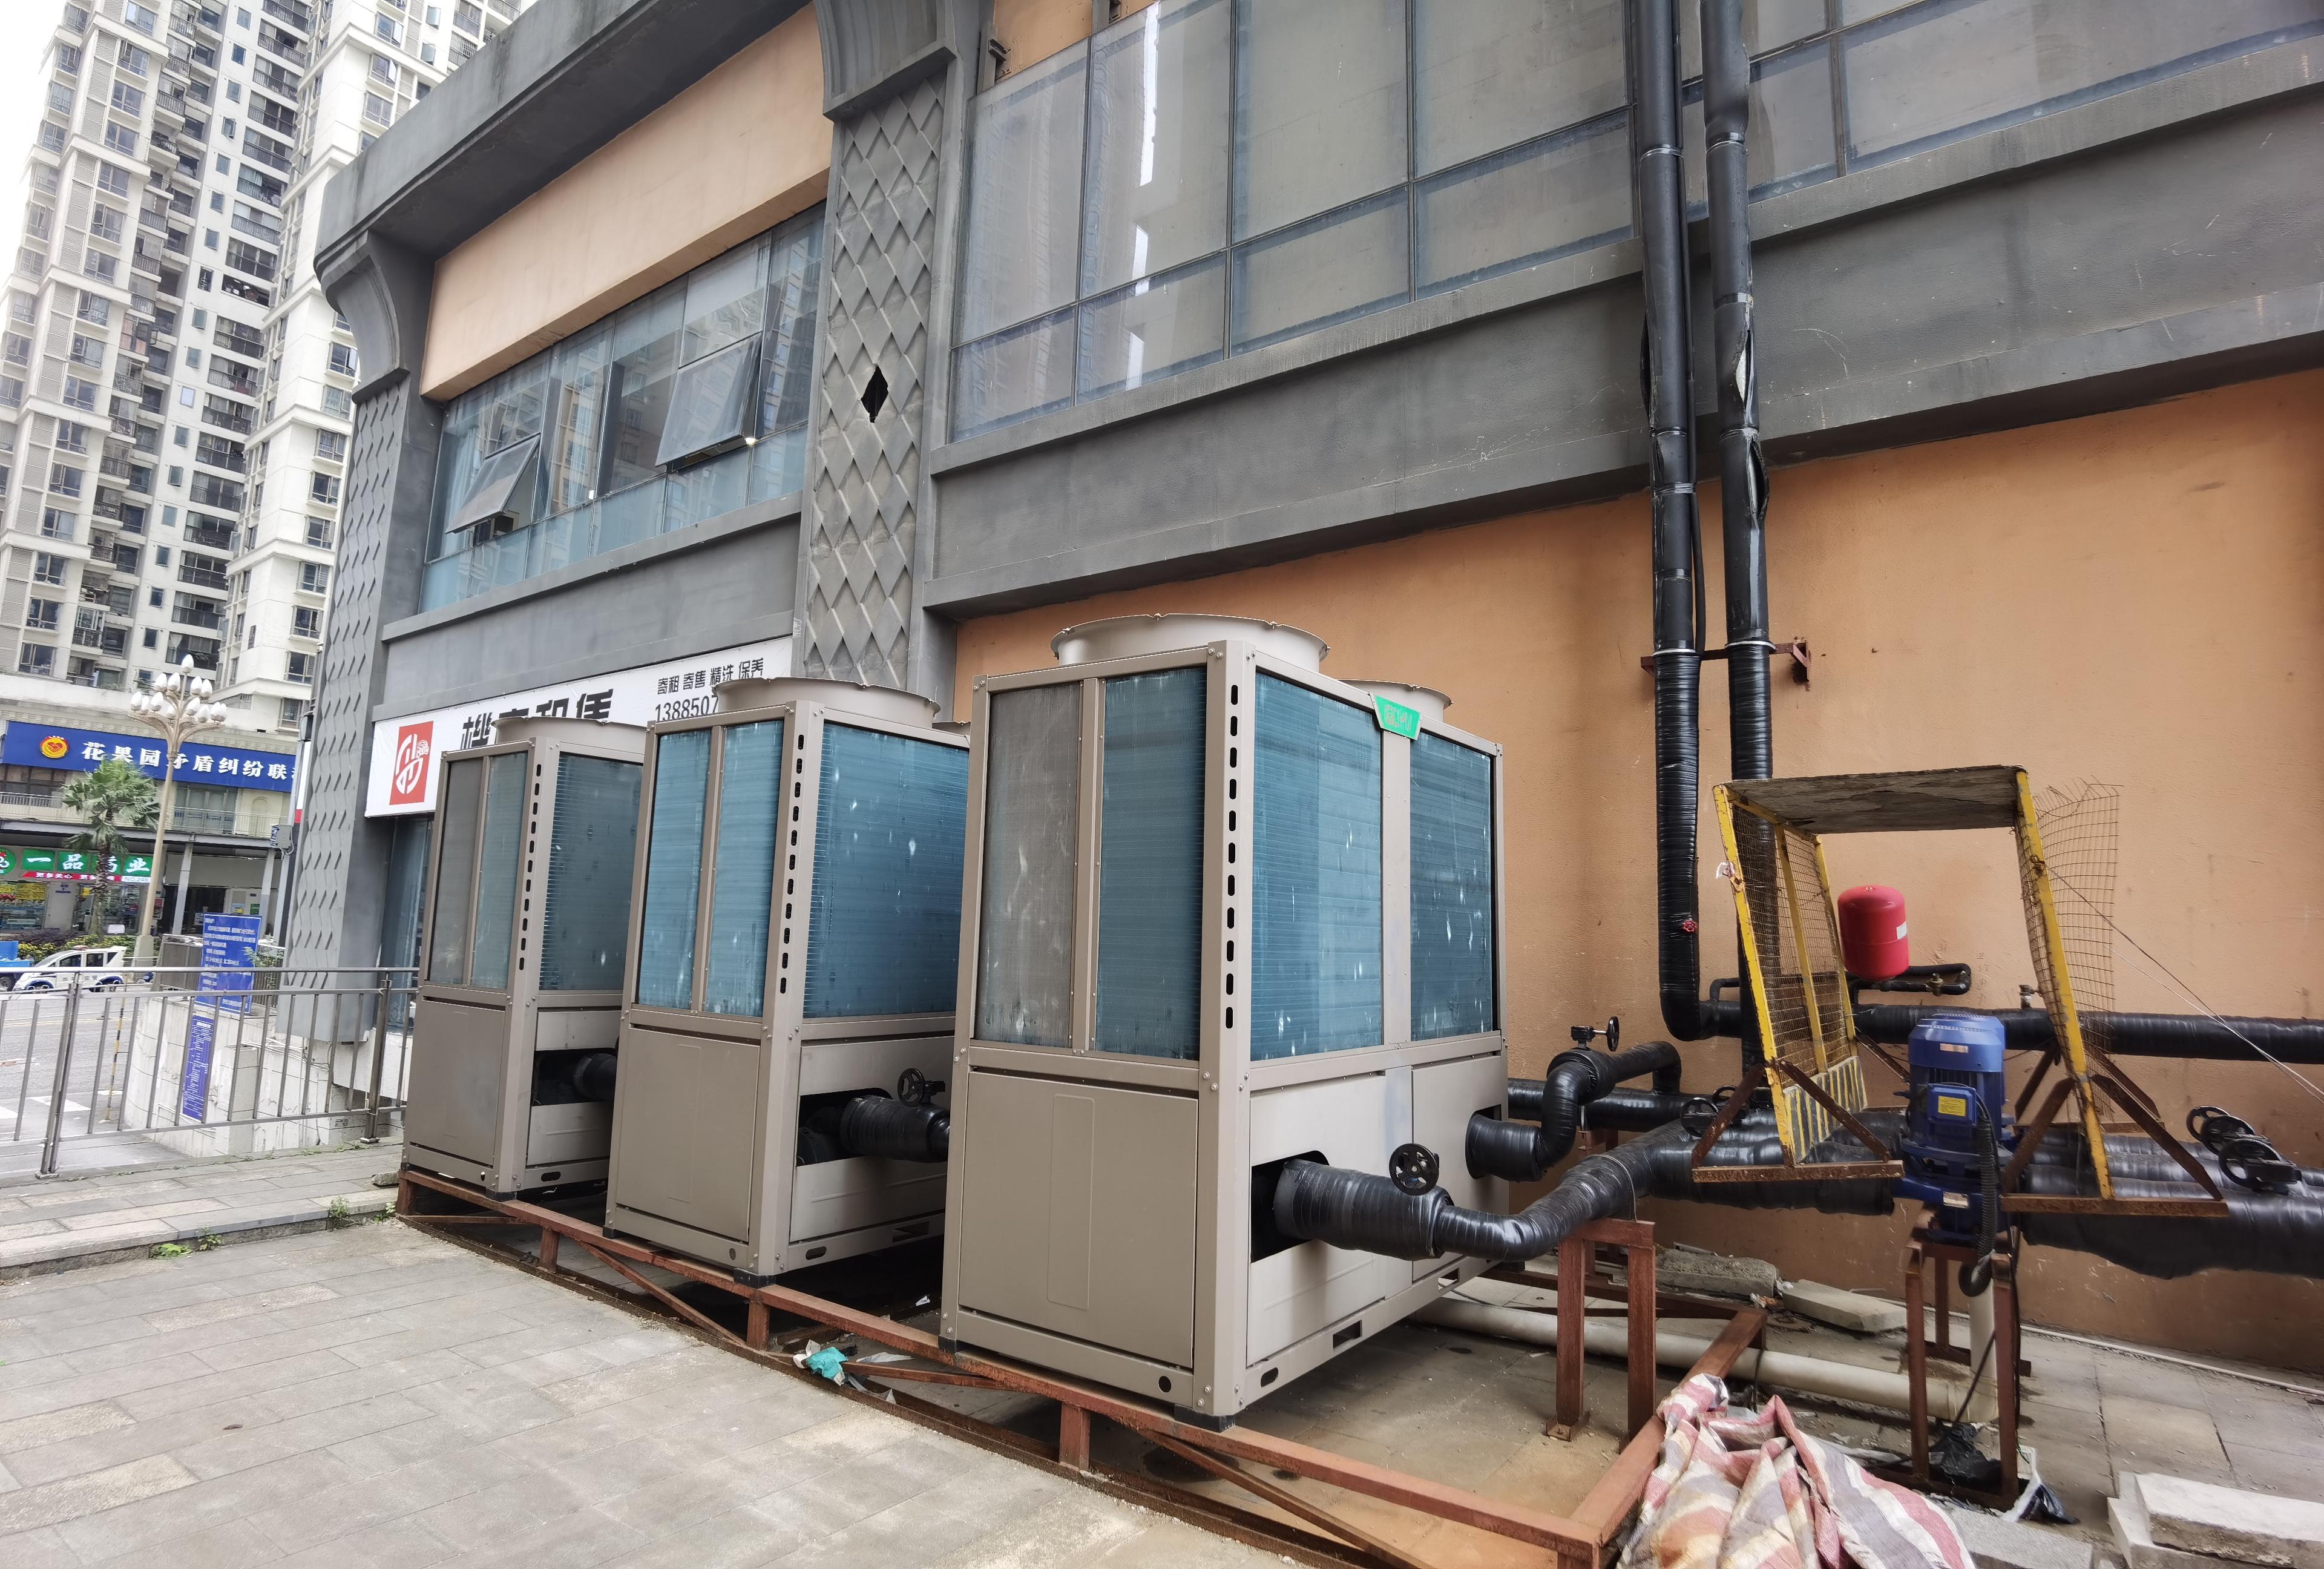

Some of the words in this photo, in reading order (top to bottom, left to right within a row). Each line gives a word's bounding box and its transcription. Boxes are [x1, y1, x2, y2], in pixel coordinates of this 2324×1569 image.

[657, 675, 680, 695] 寄租
[683, 670, 706, 690] 寄售
[709, 663, 734, 686] 精洗
[739, 657, 764, 679] 保养
[80, 741, 295, 780] 花果园矛盾纠纷联
